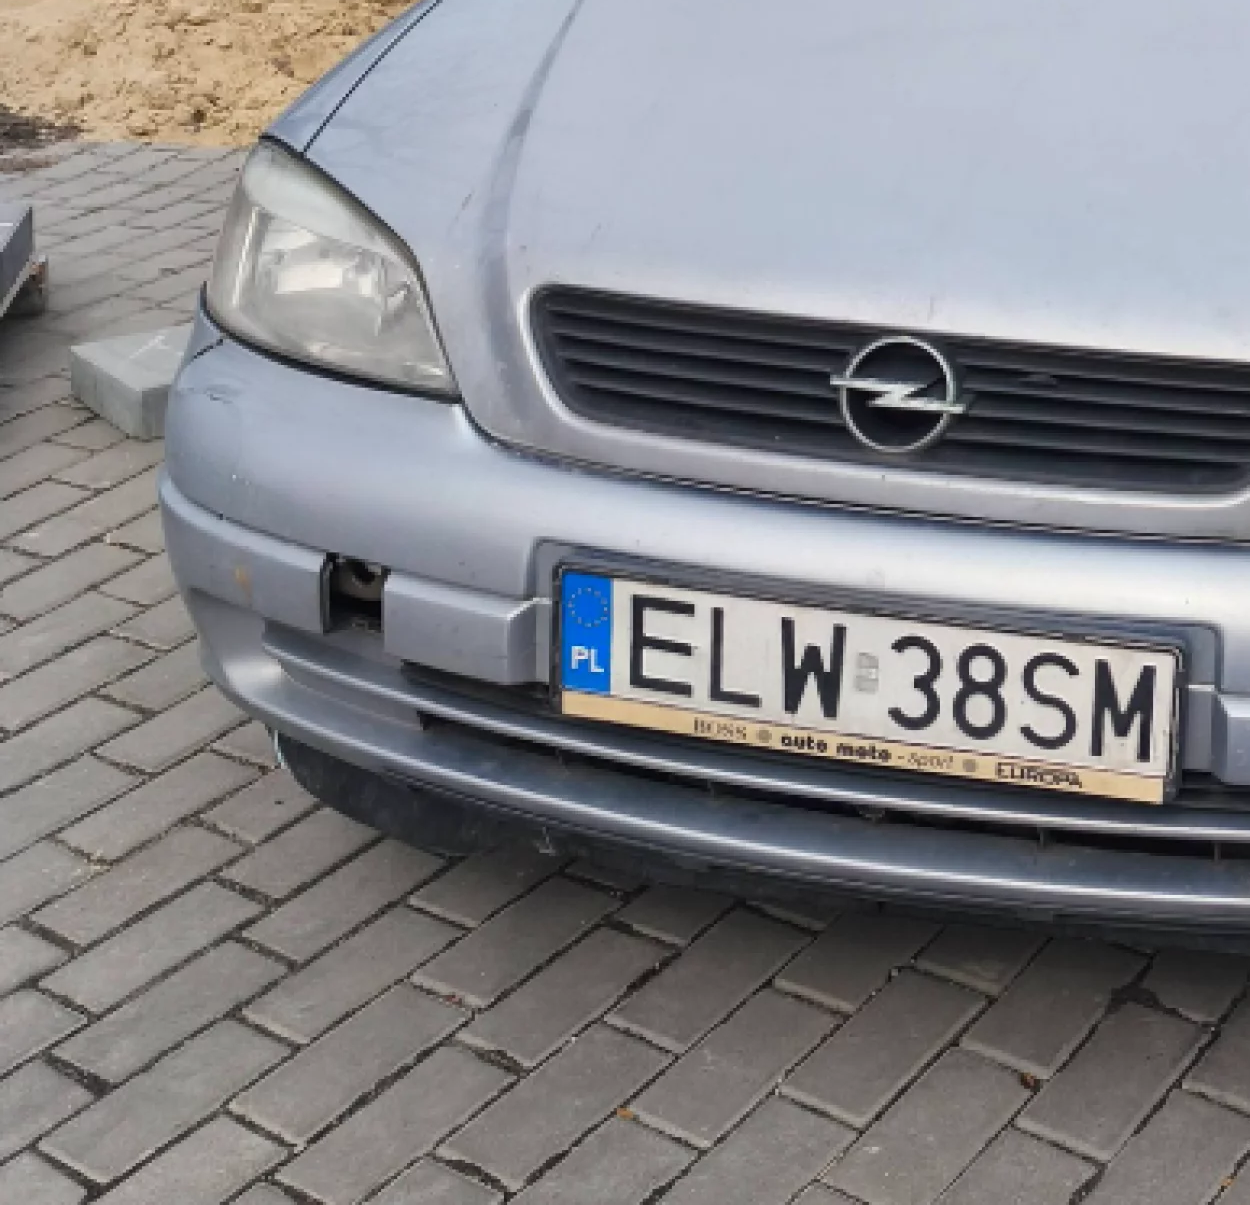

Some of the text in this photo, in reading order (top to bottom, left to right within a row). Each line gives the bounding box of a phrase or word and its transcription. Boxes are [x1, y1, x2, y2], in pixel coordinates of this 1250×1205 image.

[570, 645, 605, 675] PL
[629, 593, 1157, 763] ELW 38SM
[780, 734, 828, 753] auto
[994, 761, 1083, 789] EUROPA
